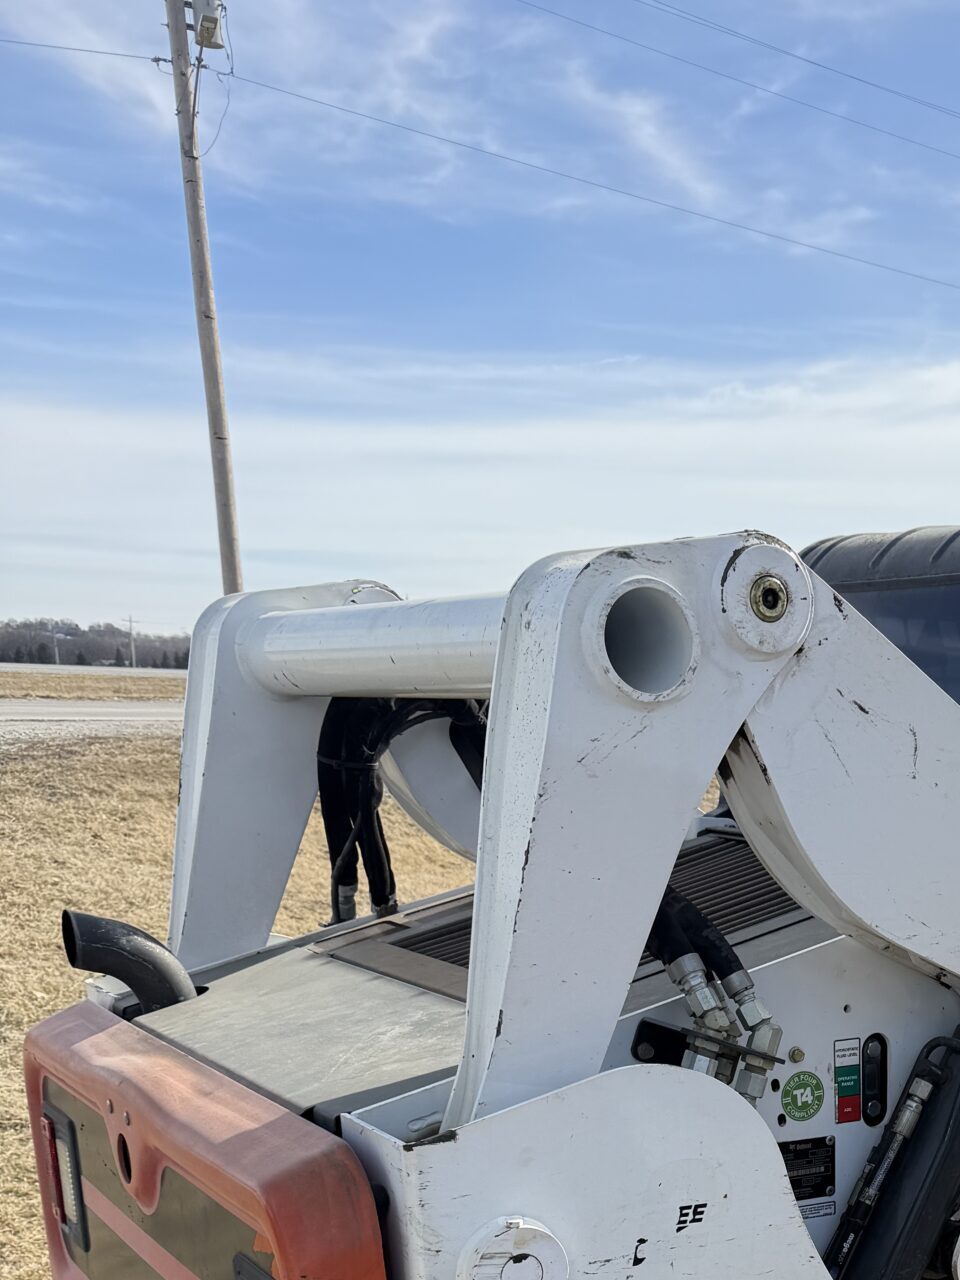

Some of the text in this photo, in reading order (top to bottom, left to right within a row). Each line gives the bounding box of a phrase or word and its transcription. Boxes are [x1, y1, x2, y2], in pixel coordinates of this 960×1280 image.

[786, 1074, 817, 1091] TIER FOUR
[792, 1086, 814, 1107] T4
[786, 1101, 820, 1118] COMPLIANT
